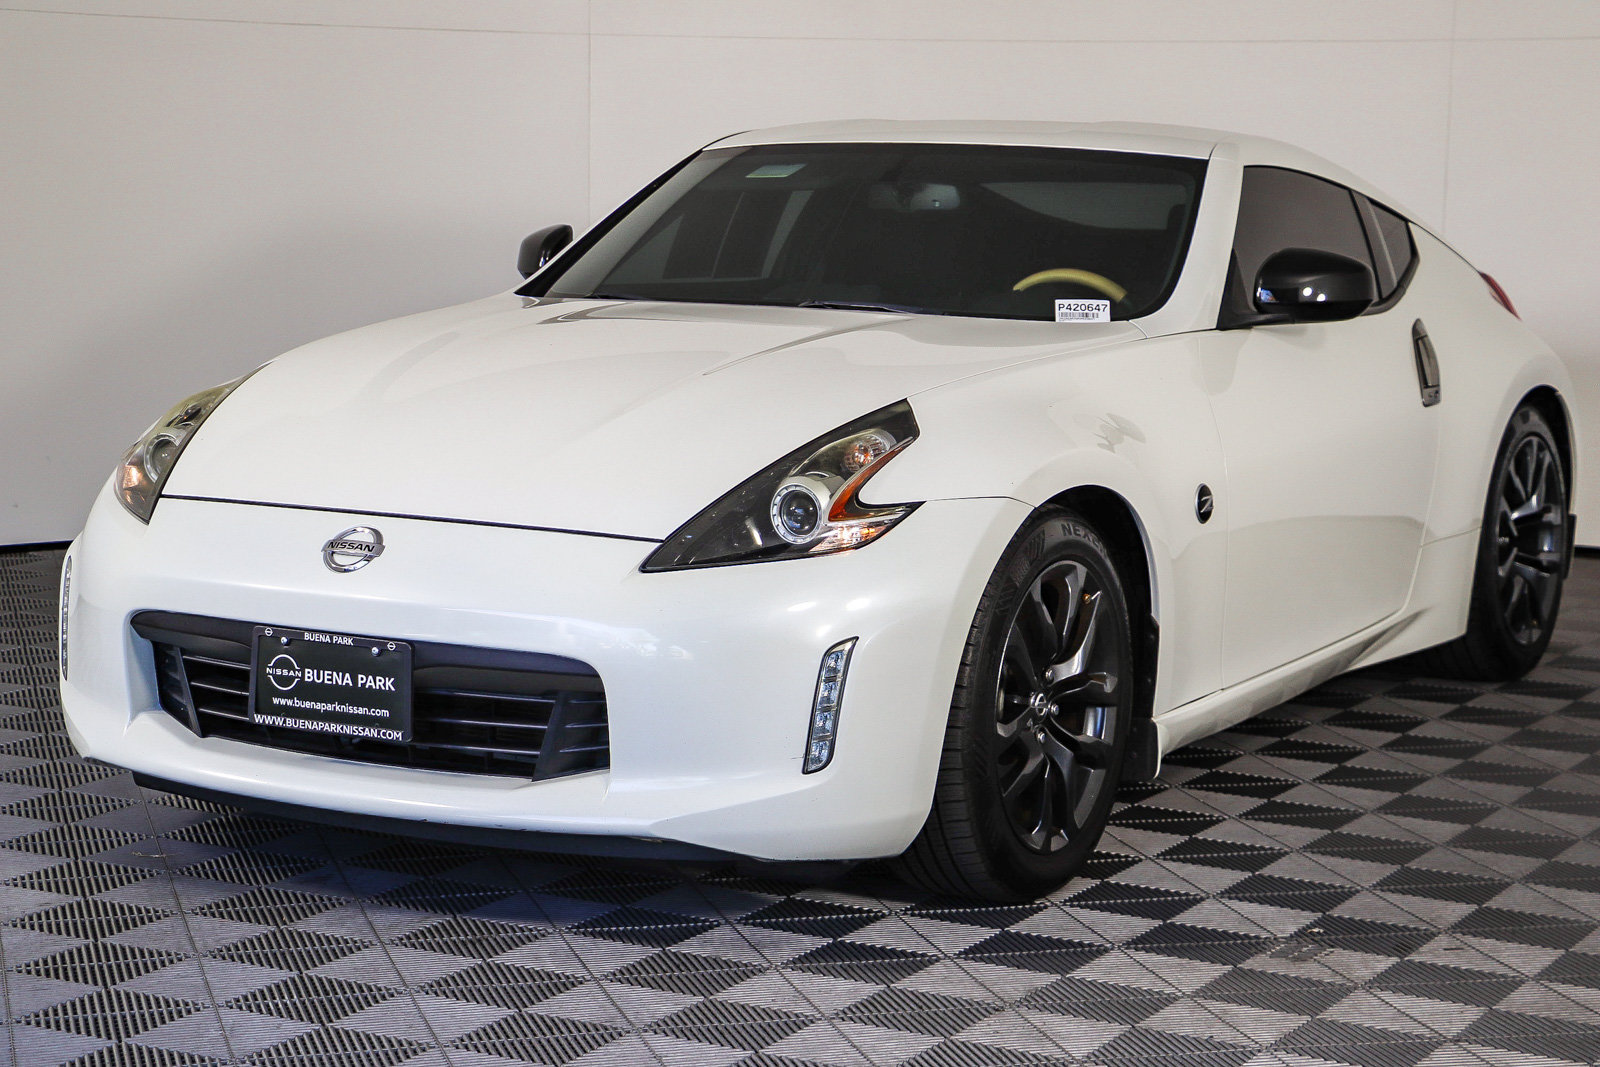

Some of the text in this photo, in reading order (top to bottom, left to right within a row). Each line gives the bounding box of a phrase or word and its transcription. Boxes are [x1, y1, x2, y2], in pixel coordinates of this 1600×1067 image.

[1058, 303, 1108, 312] P420647
[327, 541, 375, 552] NISSAN
[304, 632, 354, 646] BUENA PARK
[266, 667, 302, 677] NISSAN
[304, 668, 396, 691] BUENA PARK
[272, 697, 389, 717] www.buenaparknissan.com
[254, 713, 402, 740] WWW.BUENAPARKNISSAN.COM
